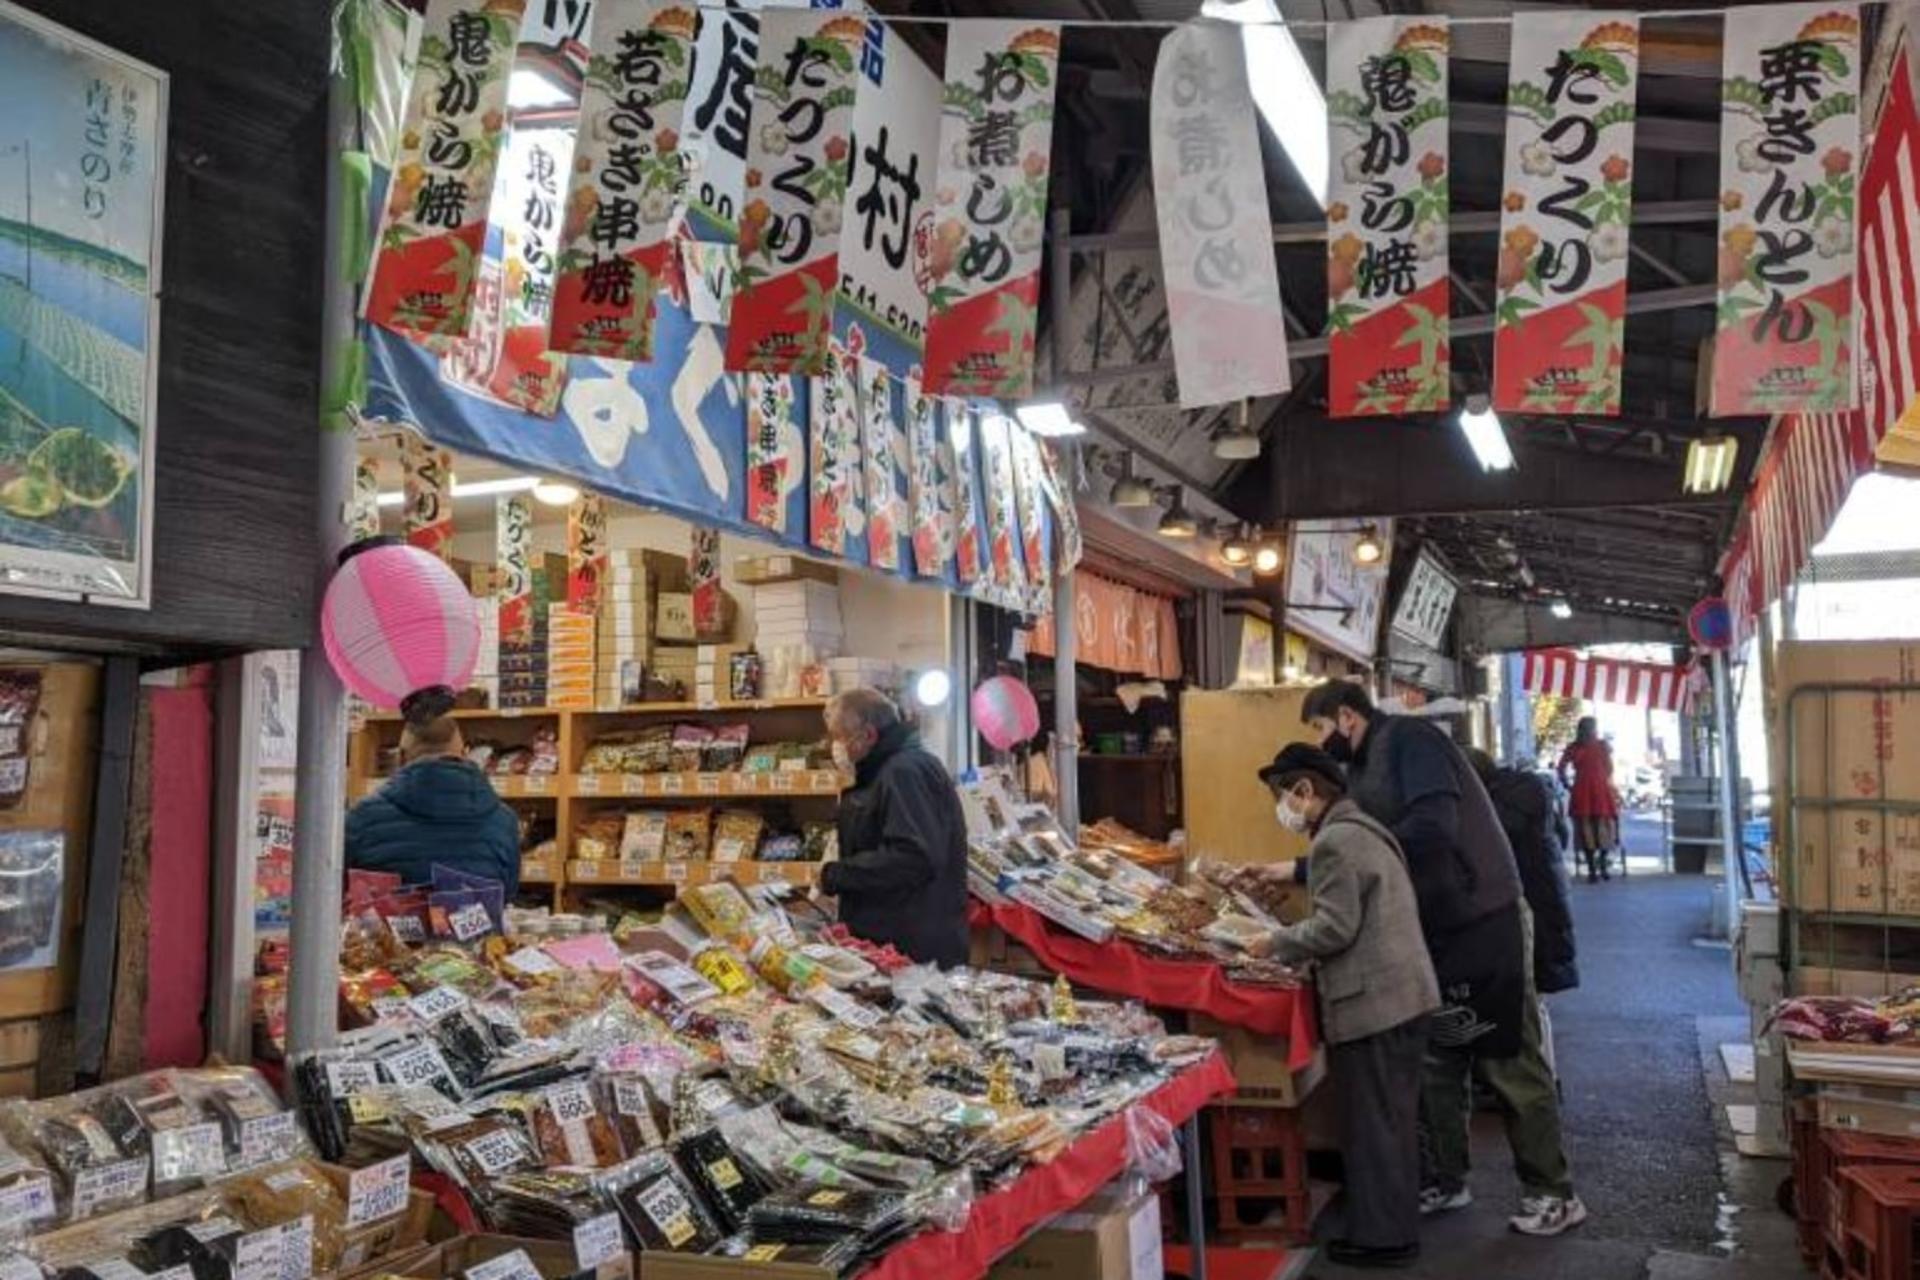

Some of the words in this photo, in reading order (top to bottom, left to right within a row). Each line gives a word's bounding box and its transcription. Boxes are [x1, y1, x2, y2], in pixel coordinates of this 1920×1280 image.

[414, 11, 491, 229] 鬼がら焼
[580, 30, 666, 307] 若さぎ串焼
[767, 37, 830, 264] たつくり
[960, 50, 1028, 282] お煮しめ
[1357, 55, 1417, 299] 鬼がら焼
[1537, 49, 1600, 295] たつくり
[1754, 40, 1825, 345] 栗きんとん
[416, 443, 440, 522] くり
